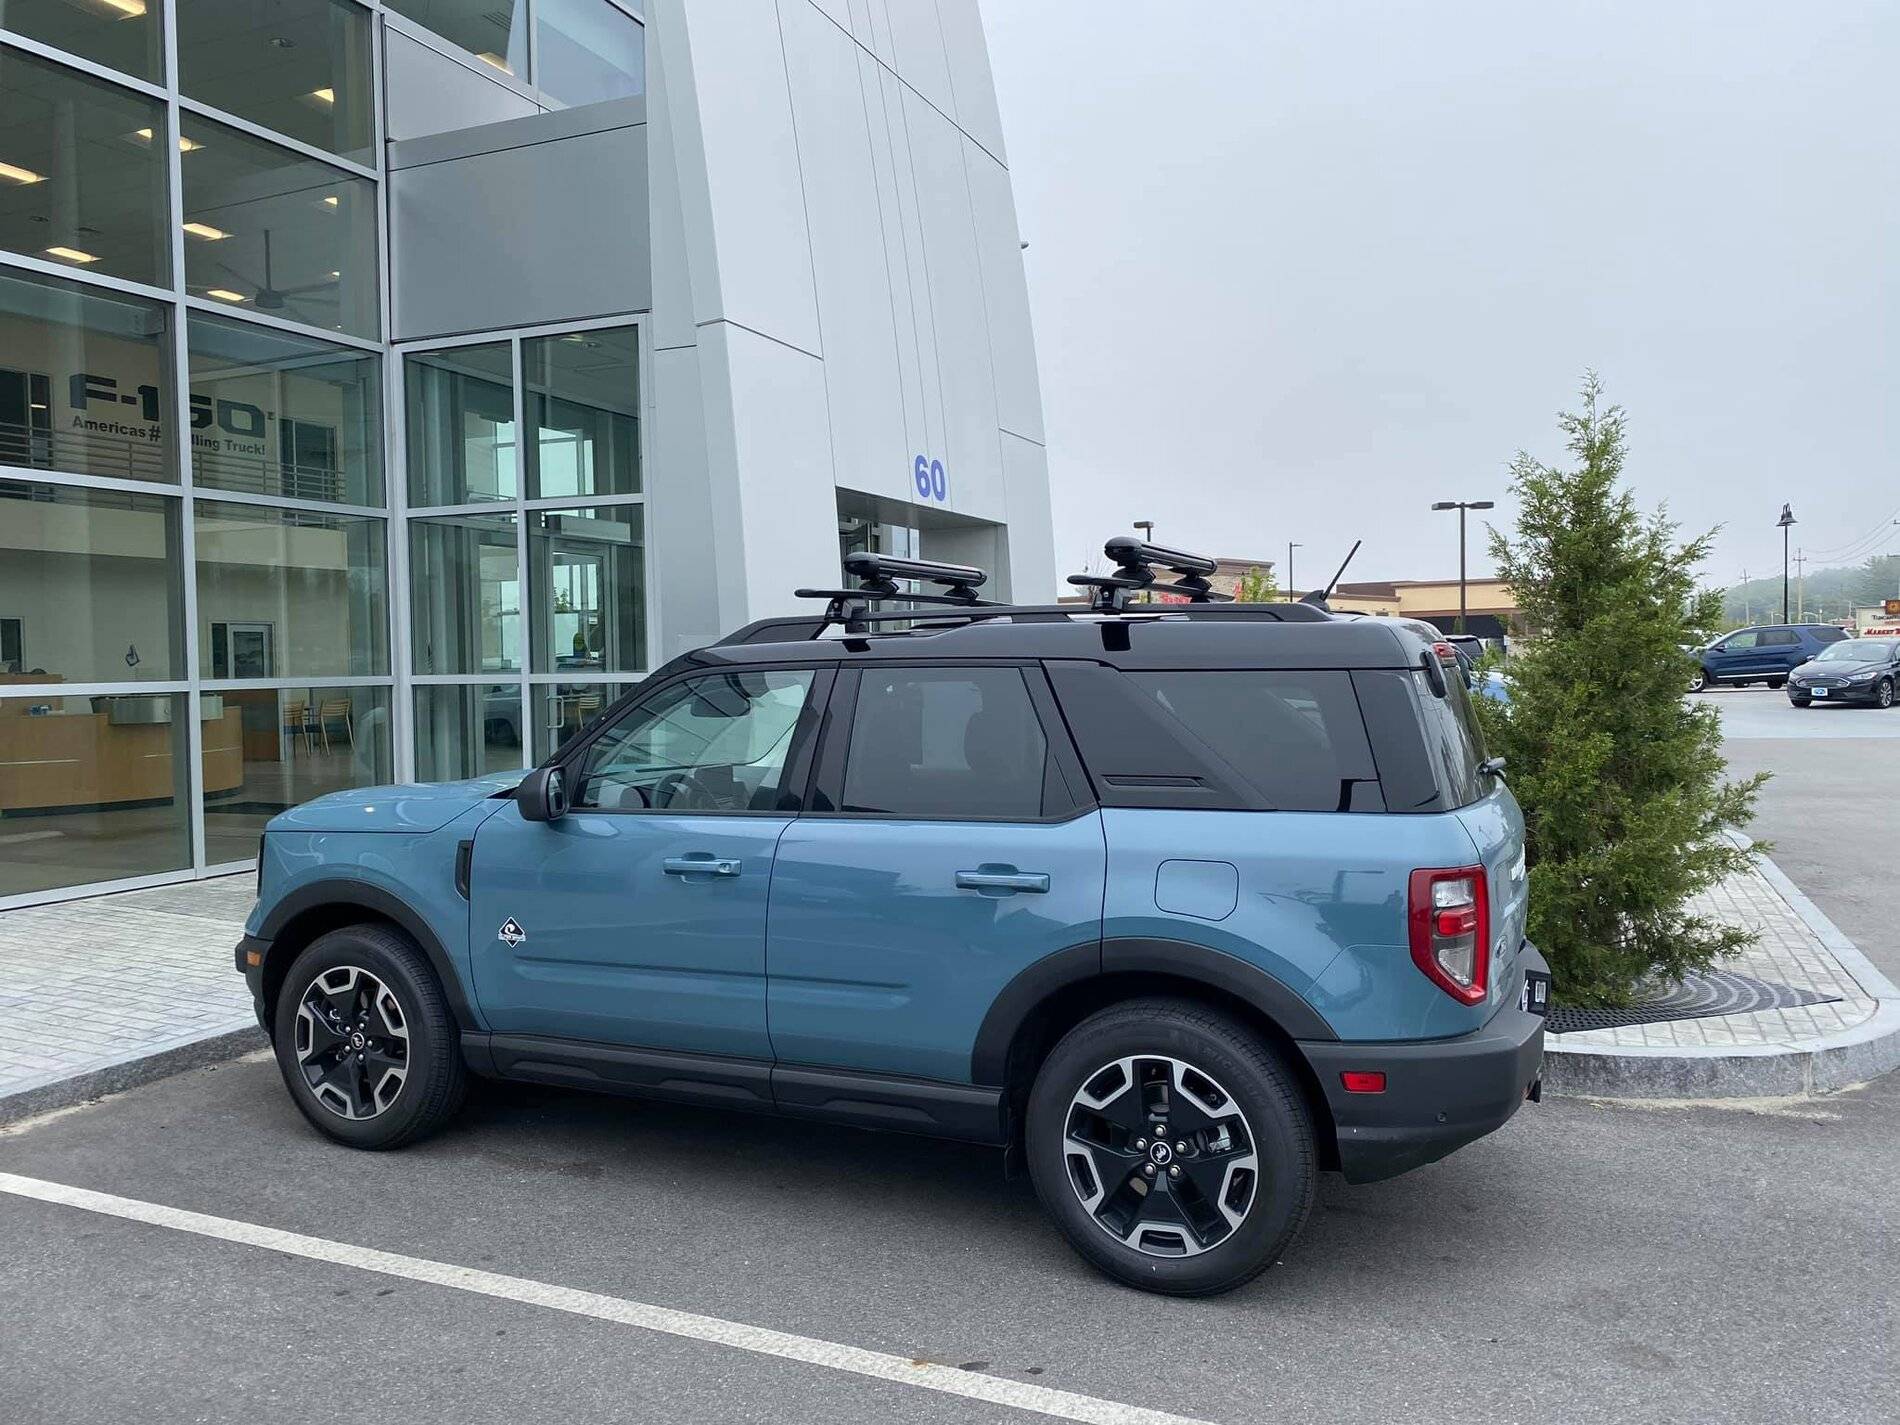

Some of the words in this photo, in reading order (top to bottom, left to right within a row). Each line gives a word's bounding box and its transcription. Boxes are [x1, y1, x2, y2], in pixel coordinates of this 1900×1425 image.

[72, 415, 146, 438] Americas
[191, 434, 220, 451] lling
[224, 439, 266, 455] Truck!
[914, 454, 946, 501] 60
